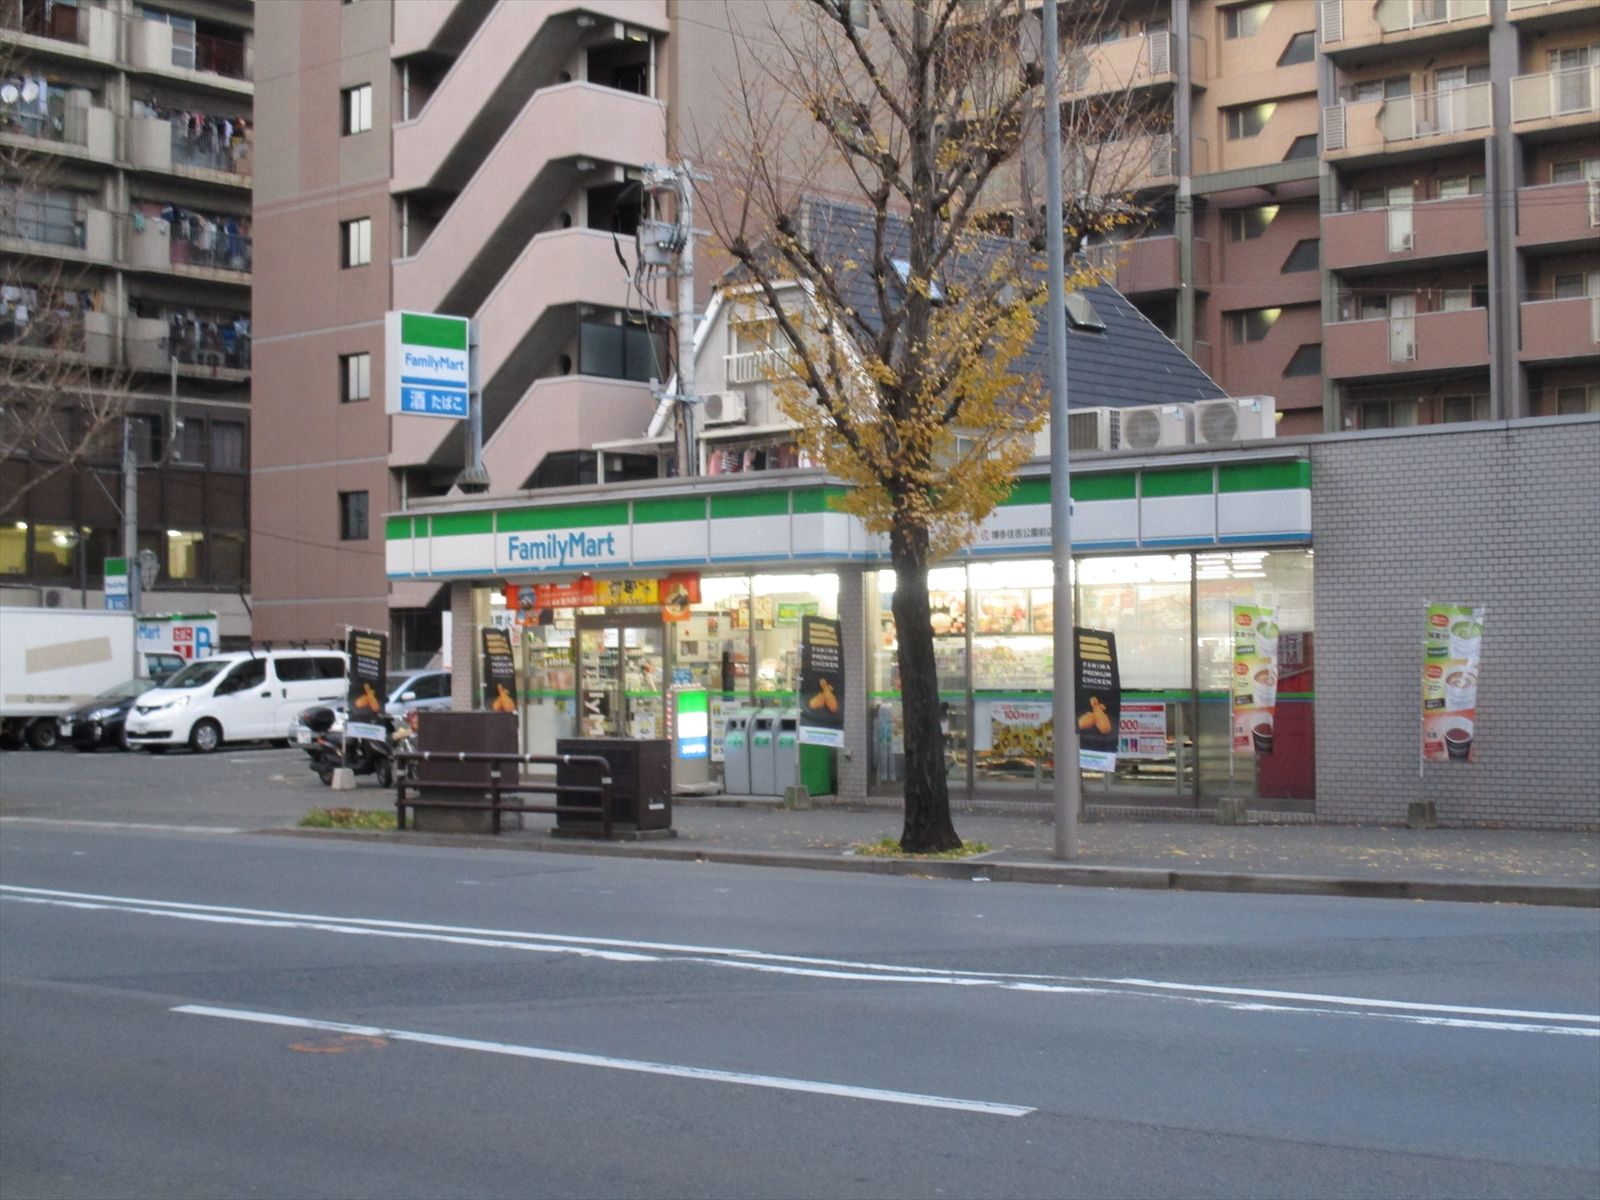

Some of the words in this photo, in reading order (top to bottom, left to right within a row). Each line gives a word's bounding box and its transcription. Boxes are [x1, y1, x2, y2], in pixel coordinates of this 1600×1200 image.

[405, 353, 465, 371] FamilyMart
[410, 390, 426, 410] 酒
[431, 394, 463, 411] たばこ
[508, 532, 615, 567] FamilyMart
